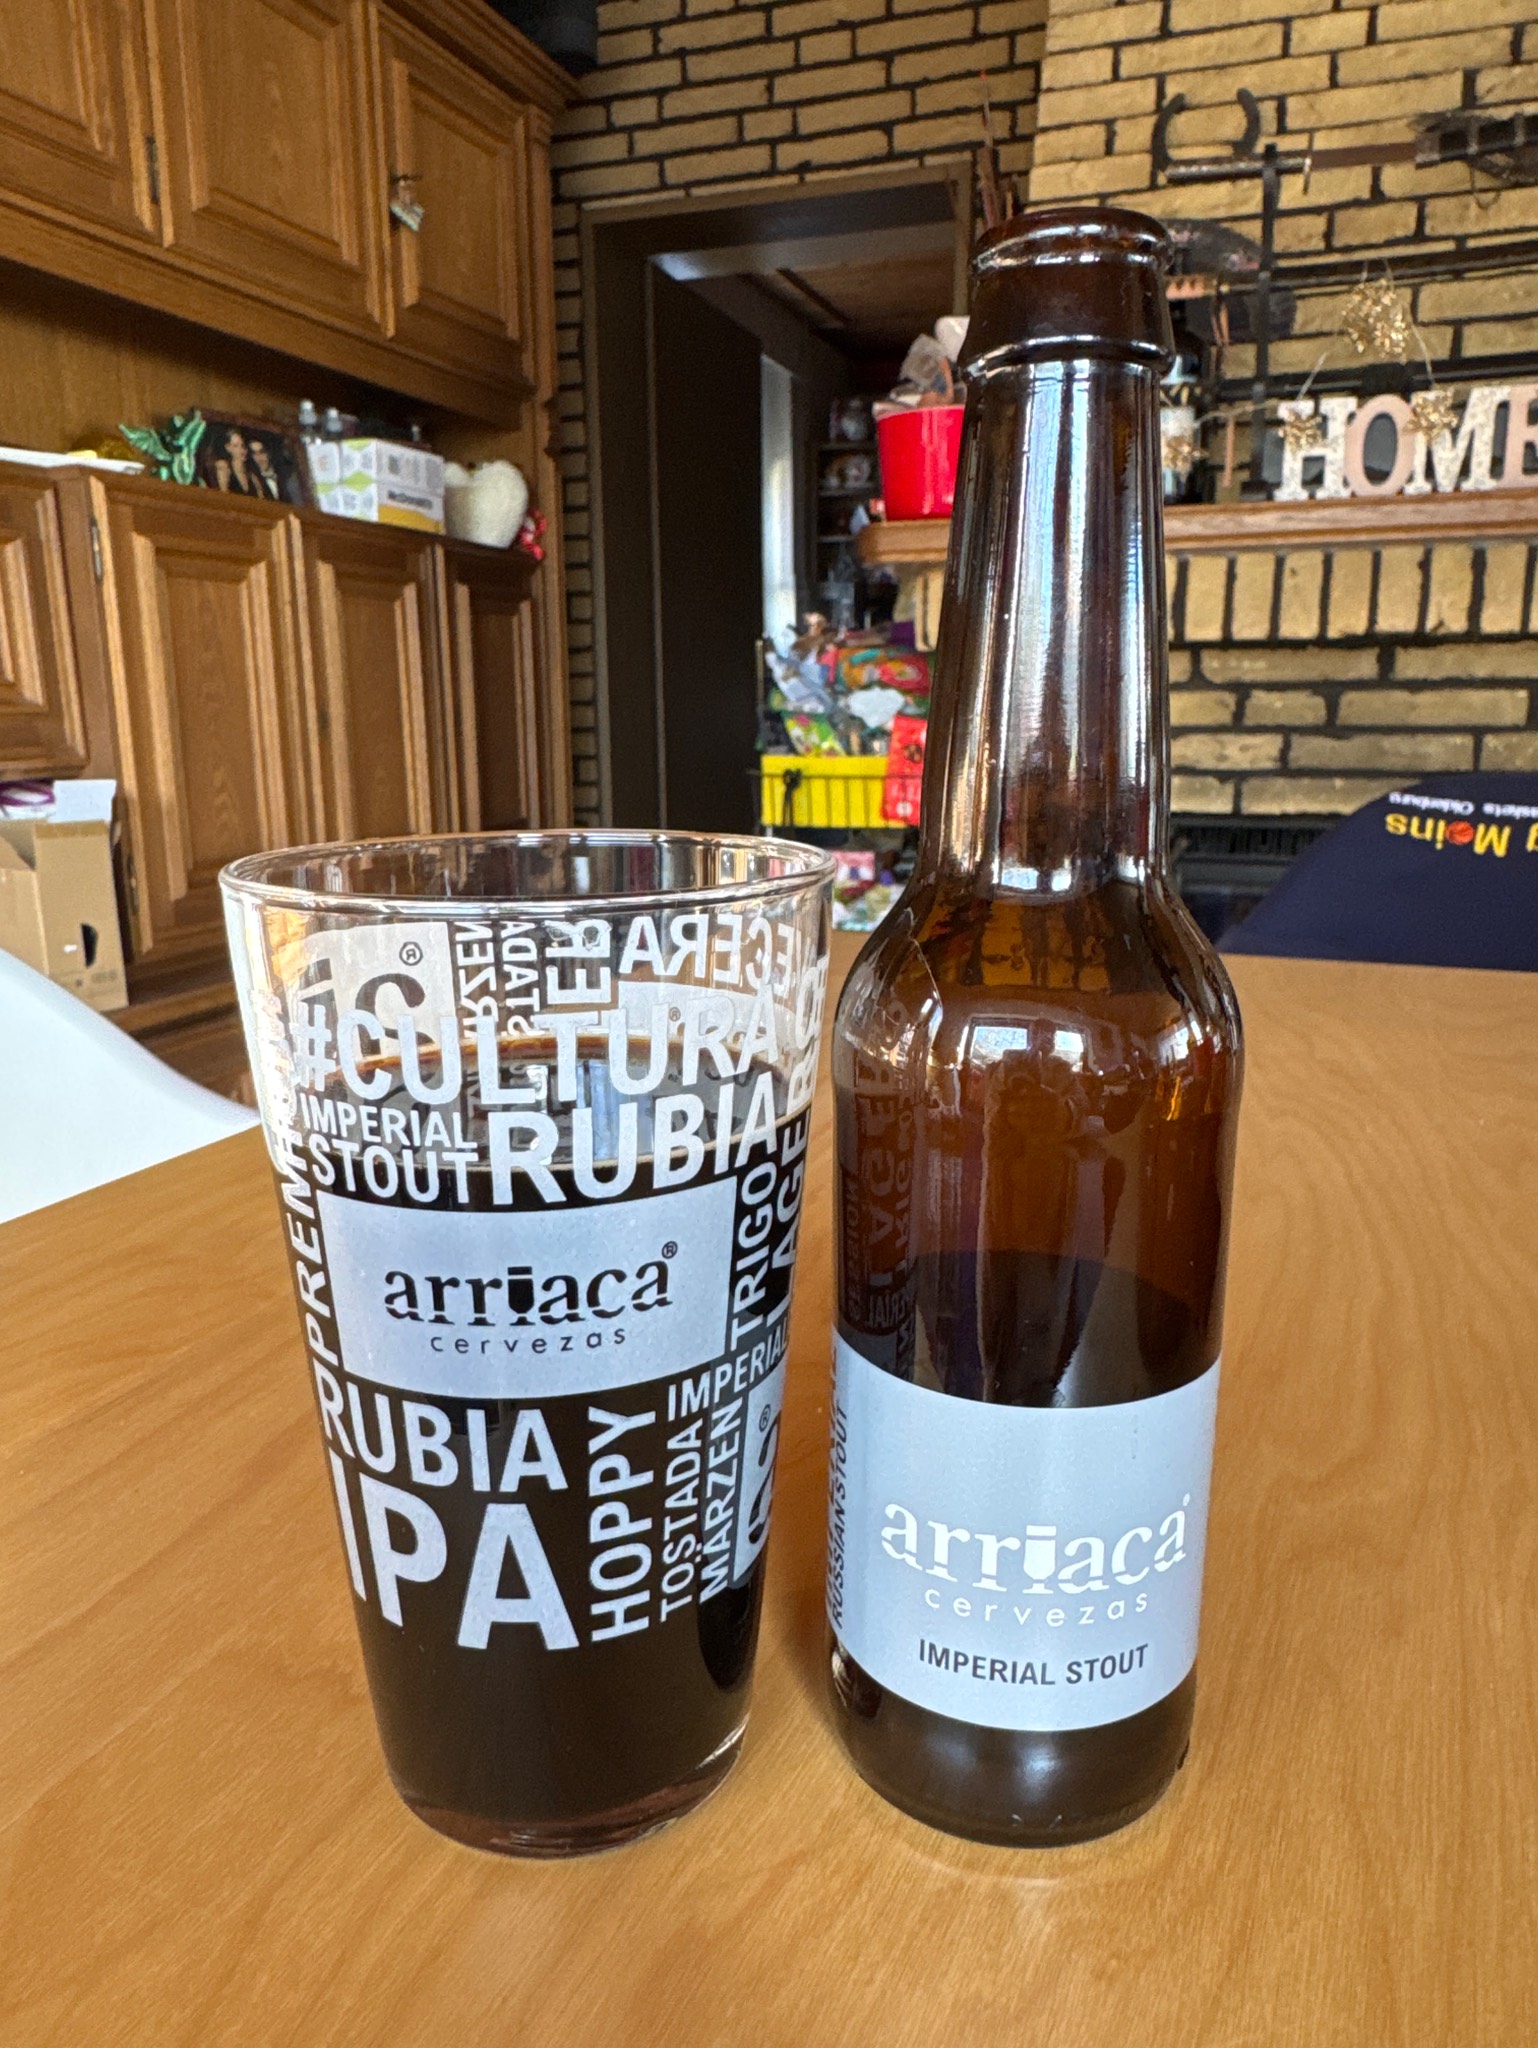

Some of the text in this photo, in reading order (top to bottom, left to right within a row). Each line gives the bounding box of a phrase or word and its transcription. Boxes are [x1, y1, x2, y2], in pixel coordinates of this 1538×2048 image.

[301, 1095, 478, 1149] IMPERIAL
[311, 1131, 482, 1204] STOUT
[488, 1072, 777, 1206] RUBIA
[730, 1161, 777, 1352] TRIGO
[430, 1326, 627, 1354] cervezas
[667, 1317, 788, 1422] IMPERIAL
[312, 1359, 569, 1493] RUBIA
[834, 1405, 848, 1500] STOUT
[327, 1446, 580, 1651] IPA
[588, 1406, 657, 1643] HOPPY
[660, 1418, 703, 1623] TOSTADA
[831, 1507, 846, 1630] RUSSIAN
[919, 1638, 1149, 1686] IMPERIAL STOUT
[925, 1588, 1148, 1627] cervezas
